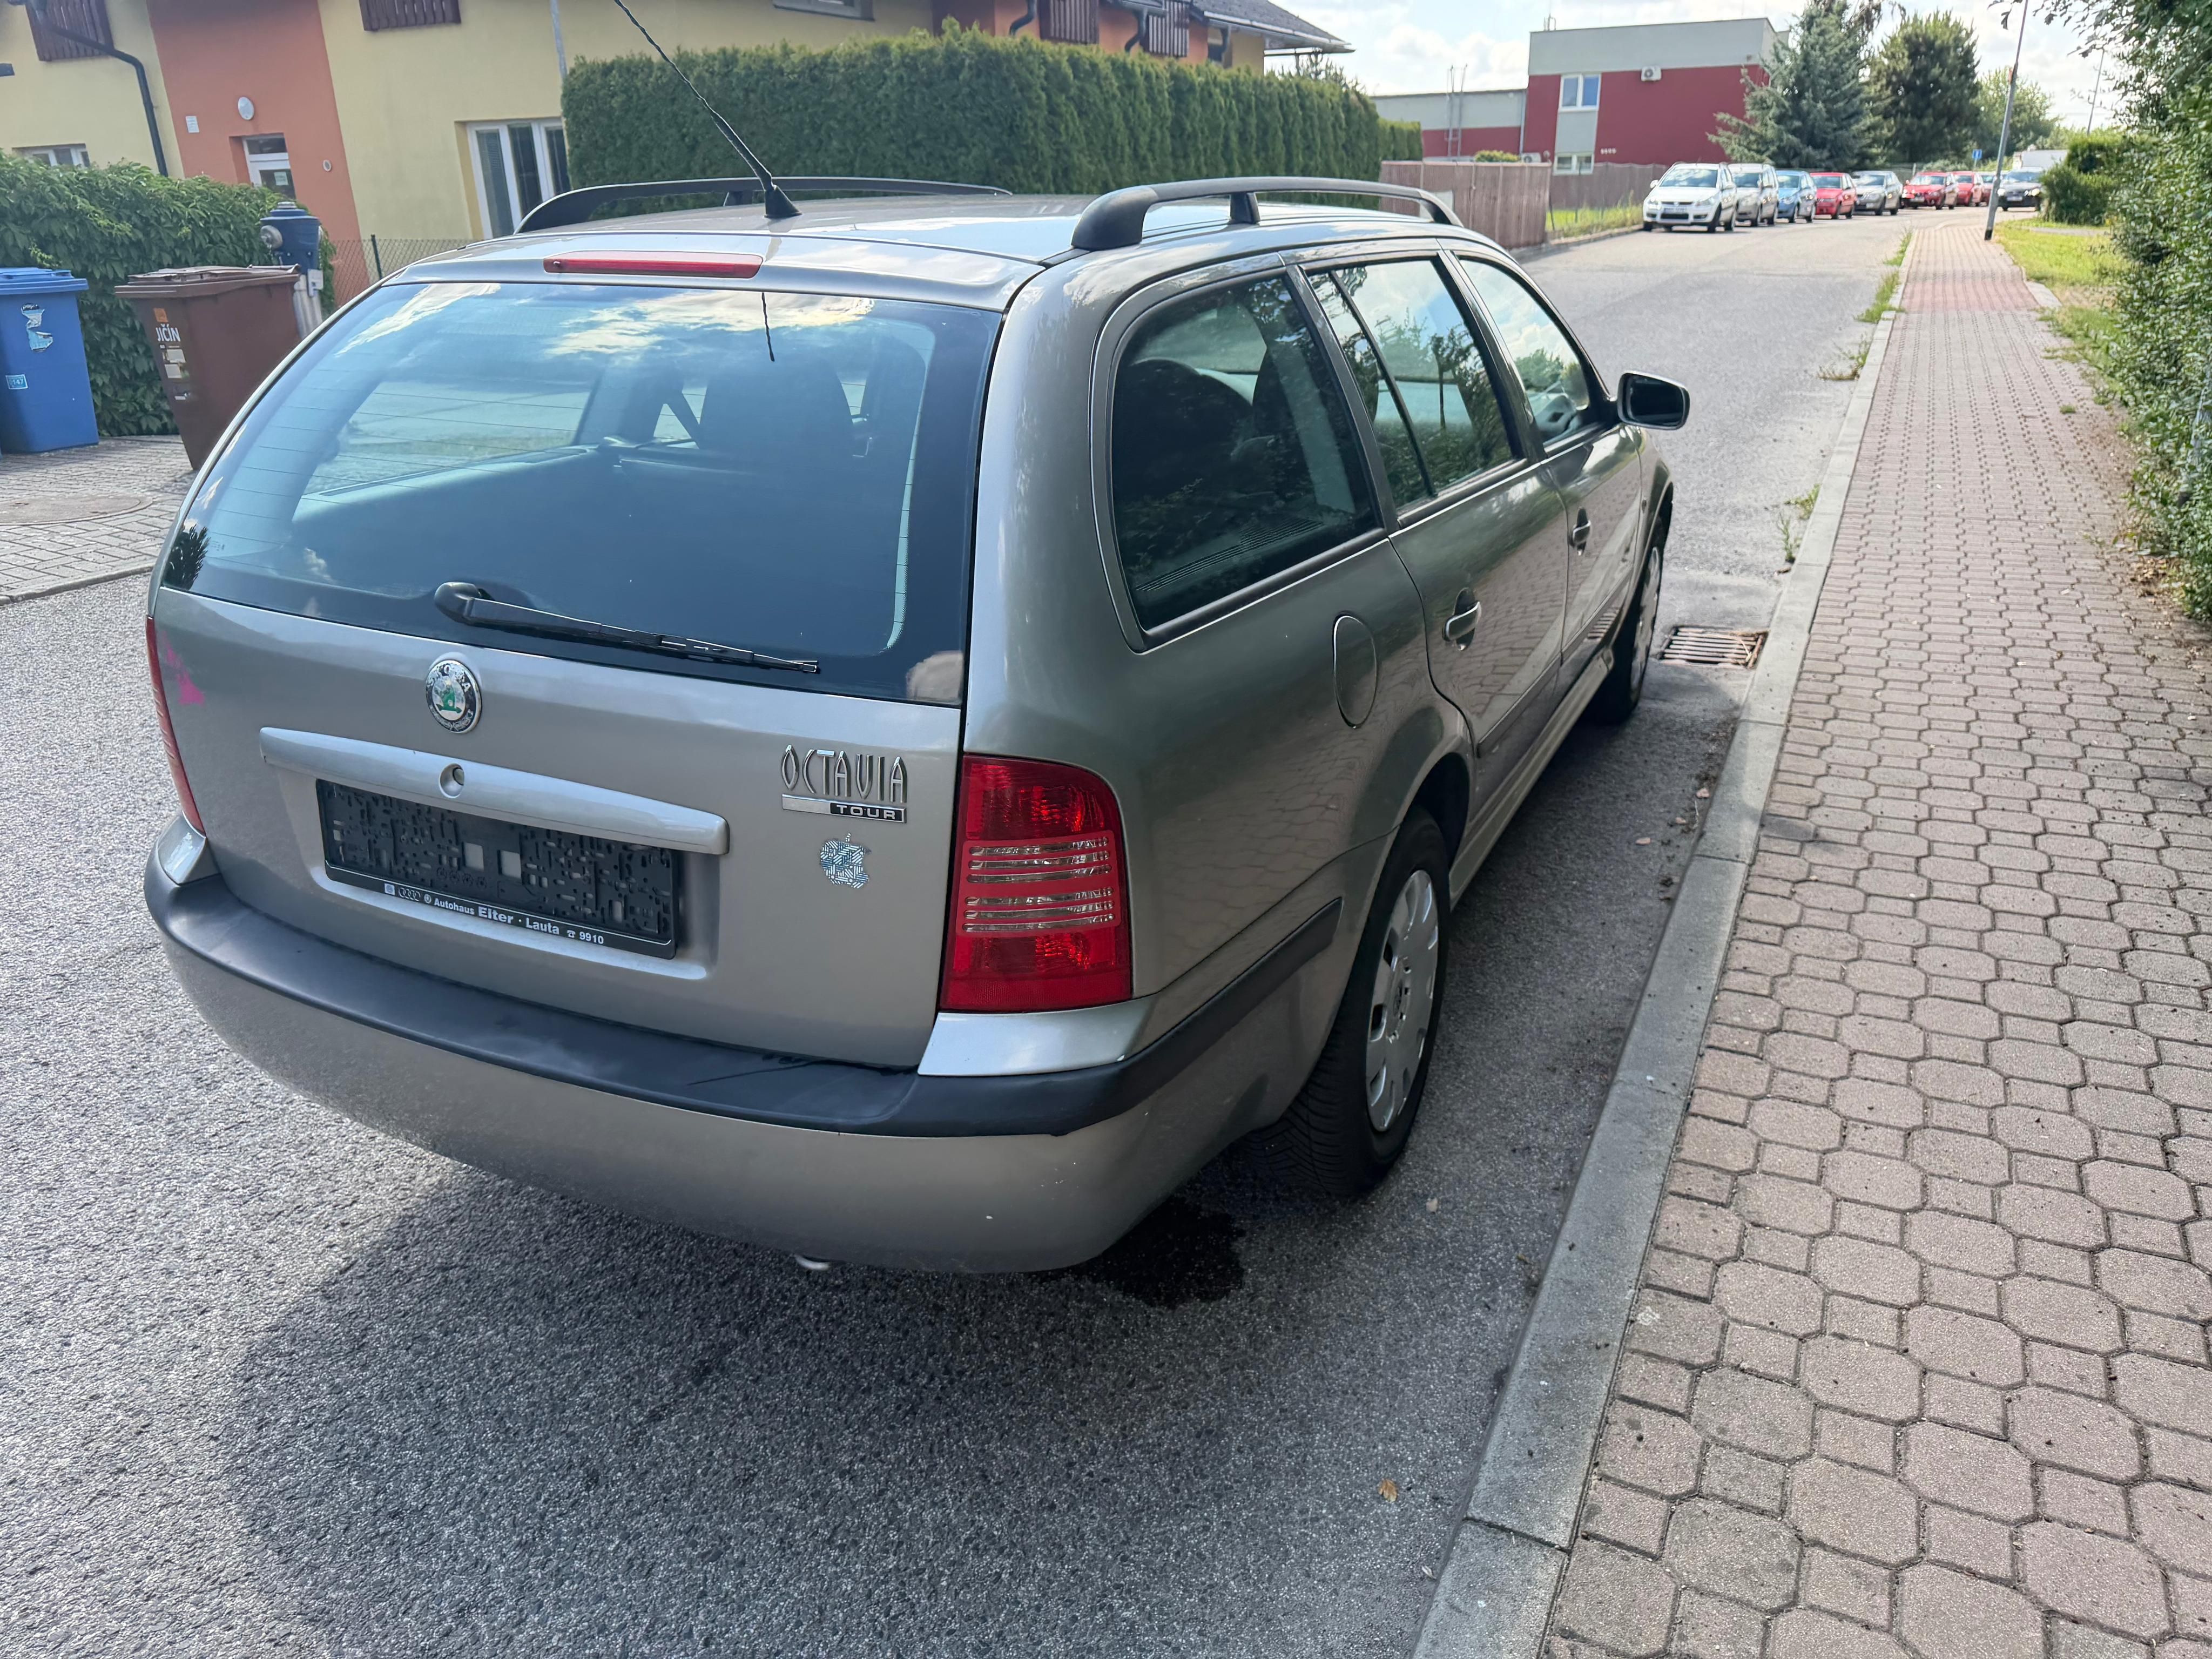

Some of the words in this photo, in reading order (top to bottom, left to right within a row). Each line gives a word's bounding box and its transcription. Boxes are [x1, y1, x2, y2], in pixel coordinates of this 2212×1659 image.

[156, 323, 181, 342] JIČÍN
[780, 744, 908, 803] OCTAVIA
[836, 804, 895, 820] TOUR
[434, 898, 475, 915] Autohaus
[526, 918, 559, 935] Lauta
[579, 931, 604, 945] 9910
